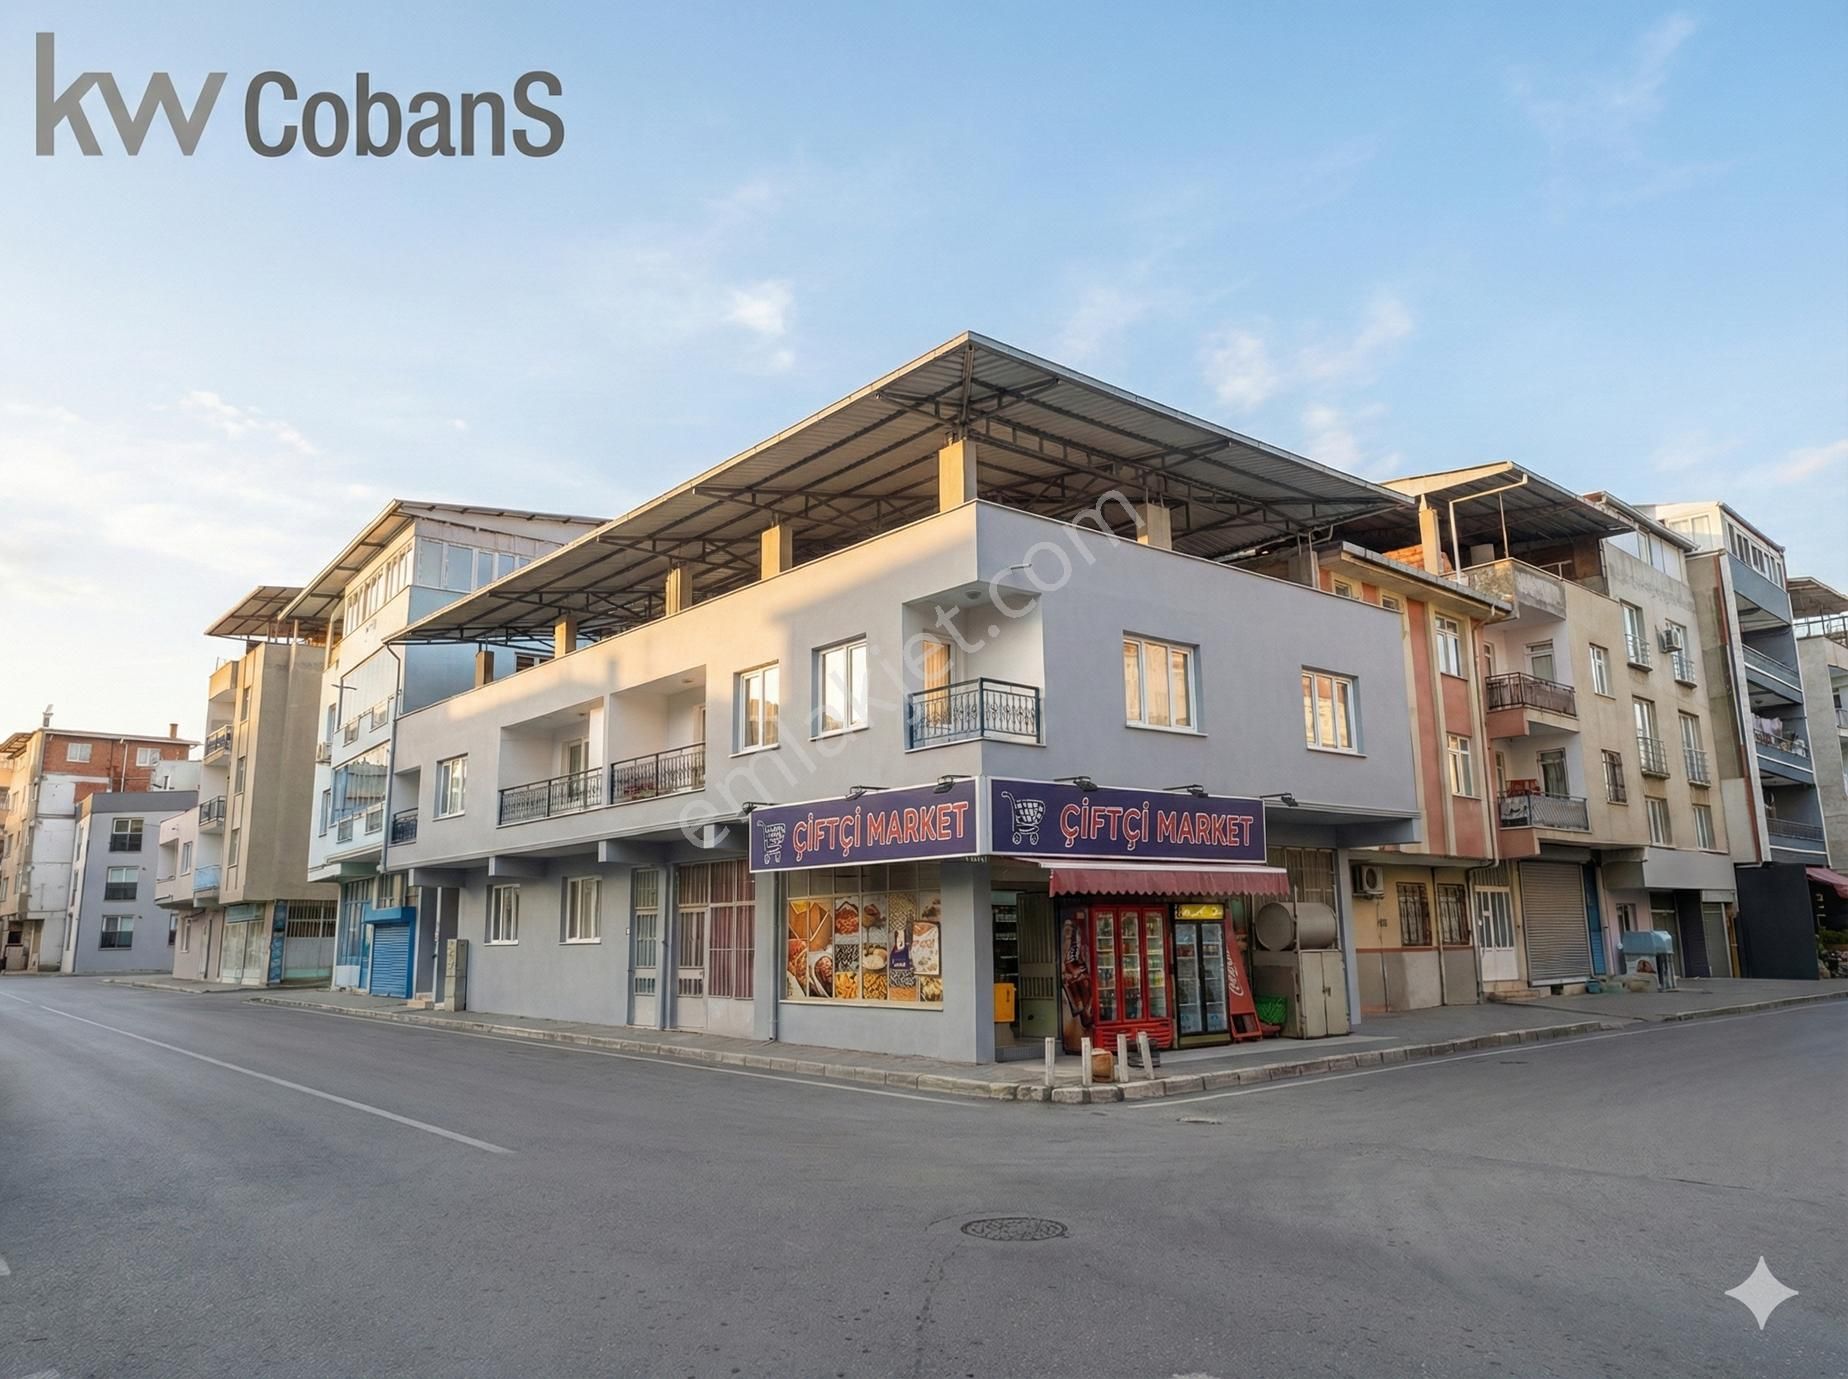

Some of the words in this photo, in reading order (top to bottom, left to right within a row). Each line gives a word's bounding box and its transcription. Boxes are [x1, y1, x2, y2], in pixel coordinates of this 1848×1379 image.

[792, 805, 861, 862] ÇİFTÇİ
[867, 801, 969, 846] MARKET
[1059, 797, 1149, 851] ÇİFTÇİ
[1156, 810, 1254, 847] MARKET
